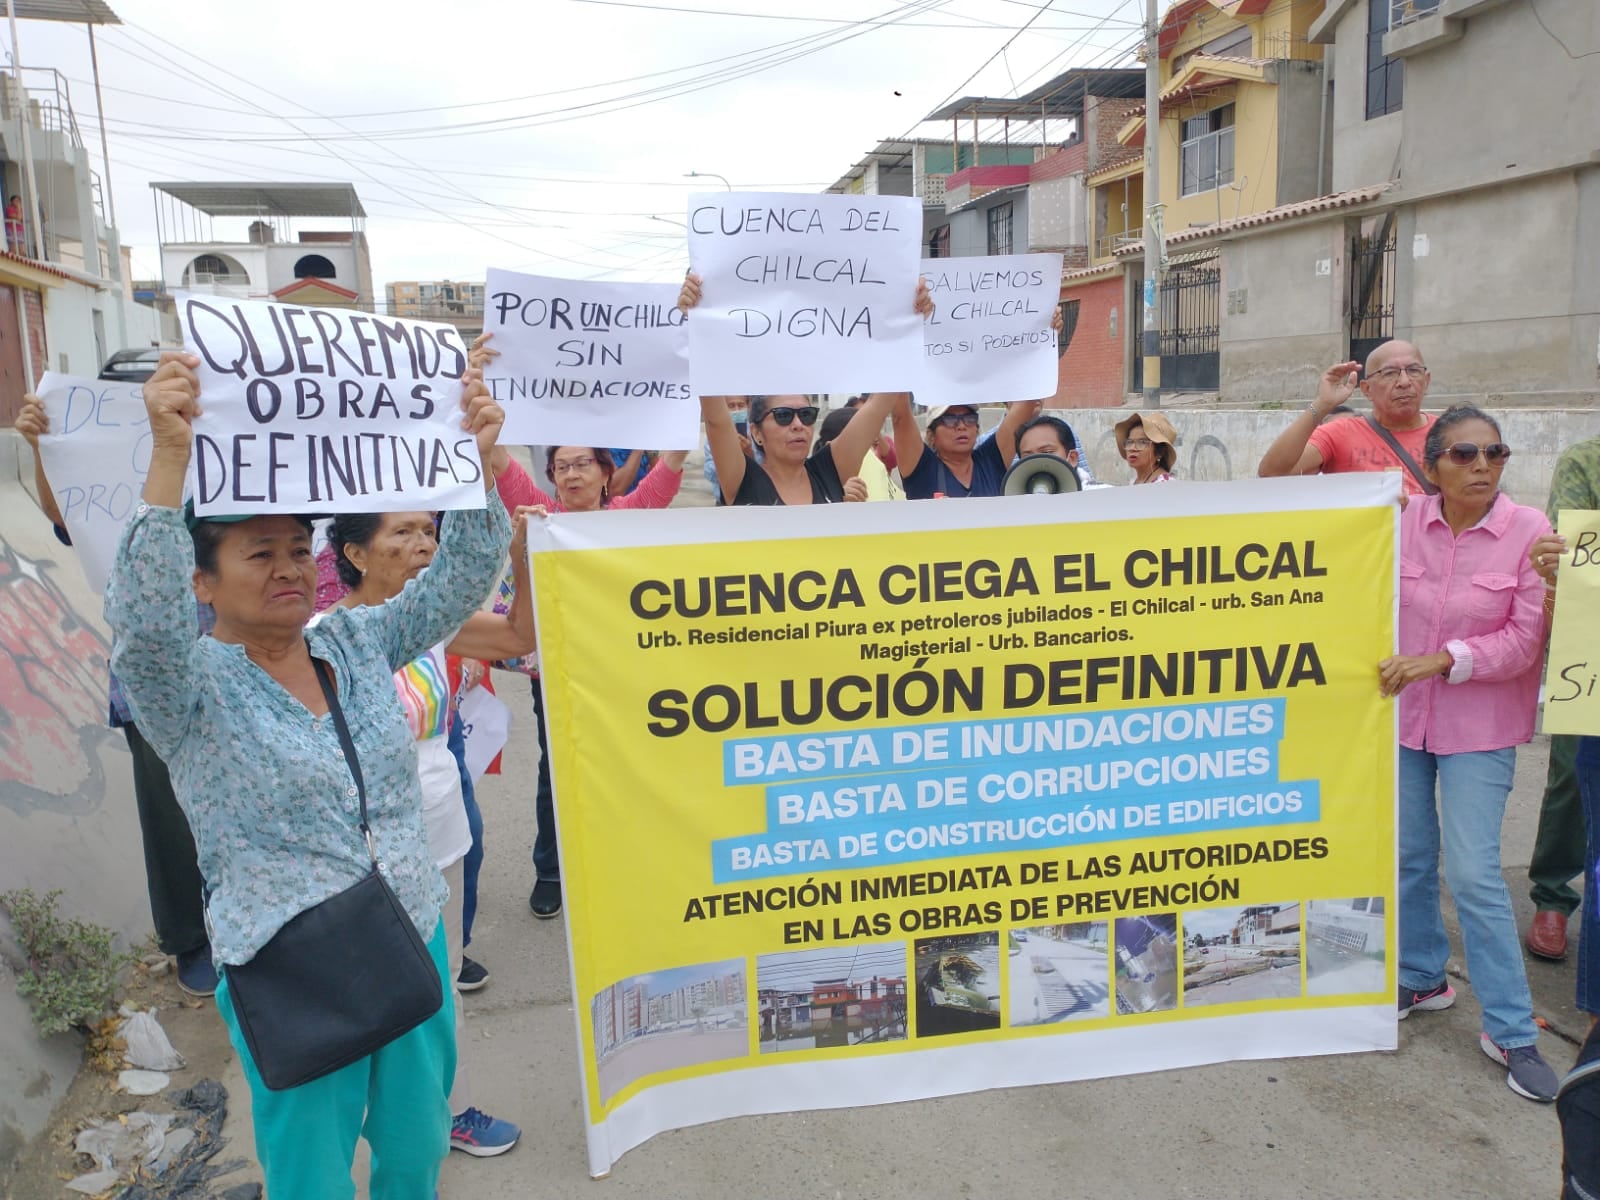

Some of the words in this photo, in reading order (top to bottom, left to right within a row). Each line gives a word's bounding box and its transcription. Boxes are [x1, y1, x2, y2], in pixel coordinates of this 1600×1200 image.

[691, 206, 824, 235] CUENCA
[840, 208, 900, 232] DEL
[735, 255, 886, 285] CHILCAL
[920, 270, 1043, 293] SALVEMOS
[491, 292, 573, 330] POR
[580, 302, 612, 332] UN
[728, 306, 872, 338] DIGNA
[951, 298, 1040, 320] CHILCAL
[186, 300, 467, 380] QUEREMOS
[555, 340, 622, 367] SIN
[958, 341, 974, 353] SI
[246, 378, 434, 424] OBRAS
[485, 376, 690, 401] INUNDACIONES
[195, 432, 481, 505] DEFINITIVAS
[629, 568, 866, 620] CUENCA
[878, 557, 1040, 606] CIEGA
[1054, 553, 1111, 594] EL
[1124, 540, 1328, 588] CHILCAL
[637, 631, 682, 649] Urb.
[688, 622, 809, 645] Residencial
[815, 620, 867, 638] Piura
[873, 621, 895, 634] ex
[901, 612, 1002, 636] petroleros
[1007, 605, 1093, 628] jubilados
[1110, 601, 1127, 617] El
[1132, 596, 1195, 615] Chilcal
[1212, 593, 1246, 610] urb.
[1251, 591, 1284, 607] San
[1289, 589, 1324, 605] Ana
[860, 637, 971, 662] Magisterial
[989, 634, 1028, 651] Urb.
[1034, 626, 1134, 647] Bancarios.
[647, 657, 984, 738] SOLUCIÓN
[1003, 642, 1327, 709] DEFINITIVA
[734, 734, 880, 778] BASTA
[893, 728, 949, 764] DE
[961, 703, 1274, 758] INUNDACIONES
[778, 783, 906, 825] BASTA
[917, 776, 967, 808] DE
[978, 747, 1270, 804] CORRUPCIONES
[731, 839, 831, 871] BASTA
[839, 832, 878, 859] DE
[885, 804, 1116, 853] CONSTRUCCIÓN
[1124, 805, 1160, 828] DE
[1168, 791, 1302, 824] EDIFICIOS
[683, 877, 841, 922] ATENCIÓN
[851, 865, 1012, 903] INMEDIATA
[1020, 862, 1059, 886] DE
[1067, 854, 1121, 881] LAS
[1129, 837, 1329, 875] AUTORIDADES
[784, 919, 824, 944] EN
[833, 912, 891, 940] LAS
[899, 901, 1002, 933] OBRAS
[1010, 896, 1048, 922] DE
[1056, 874, 1240, 916] PREVENCIÓN
